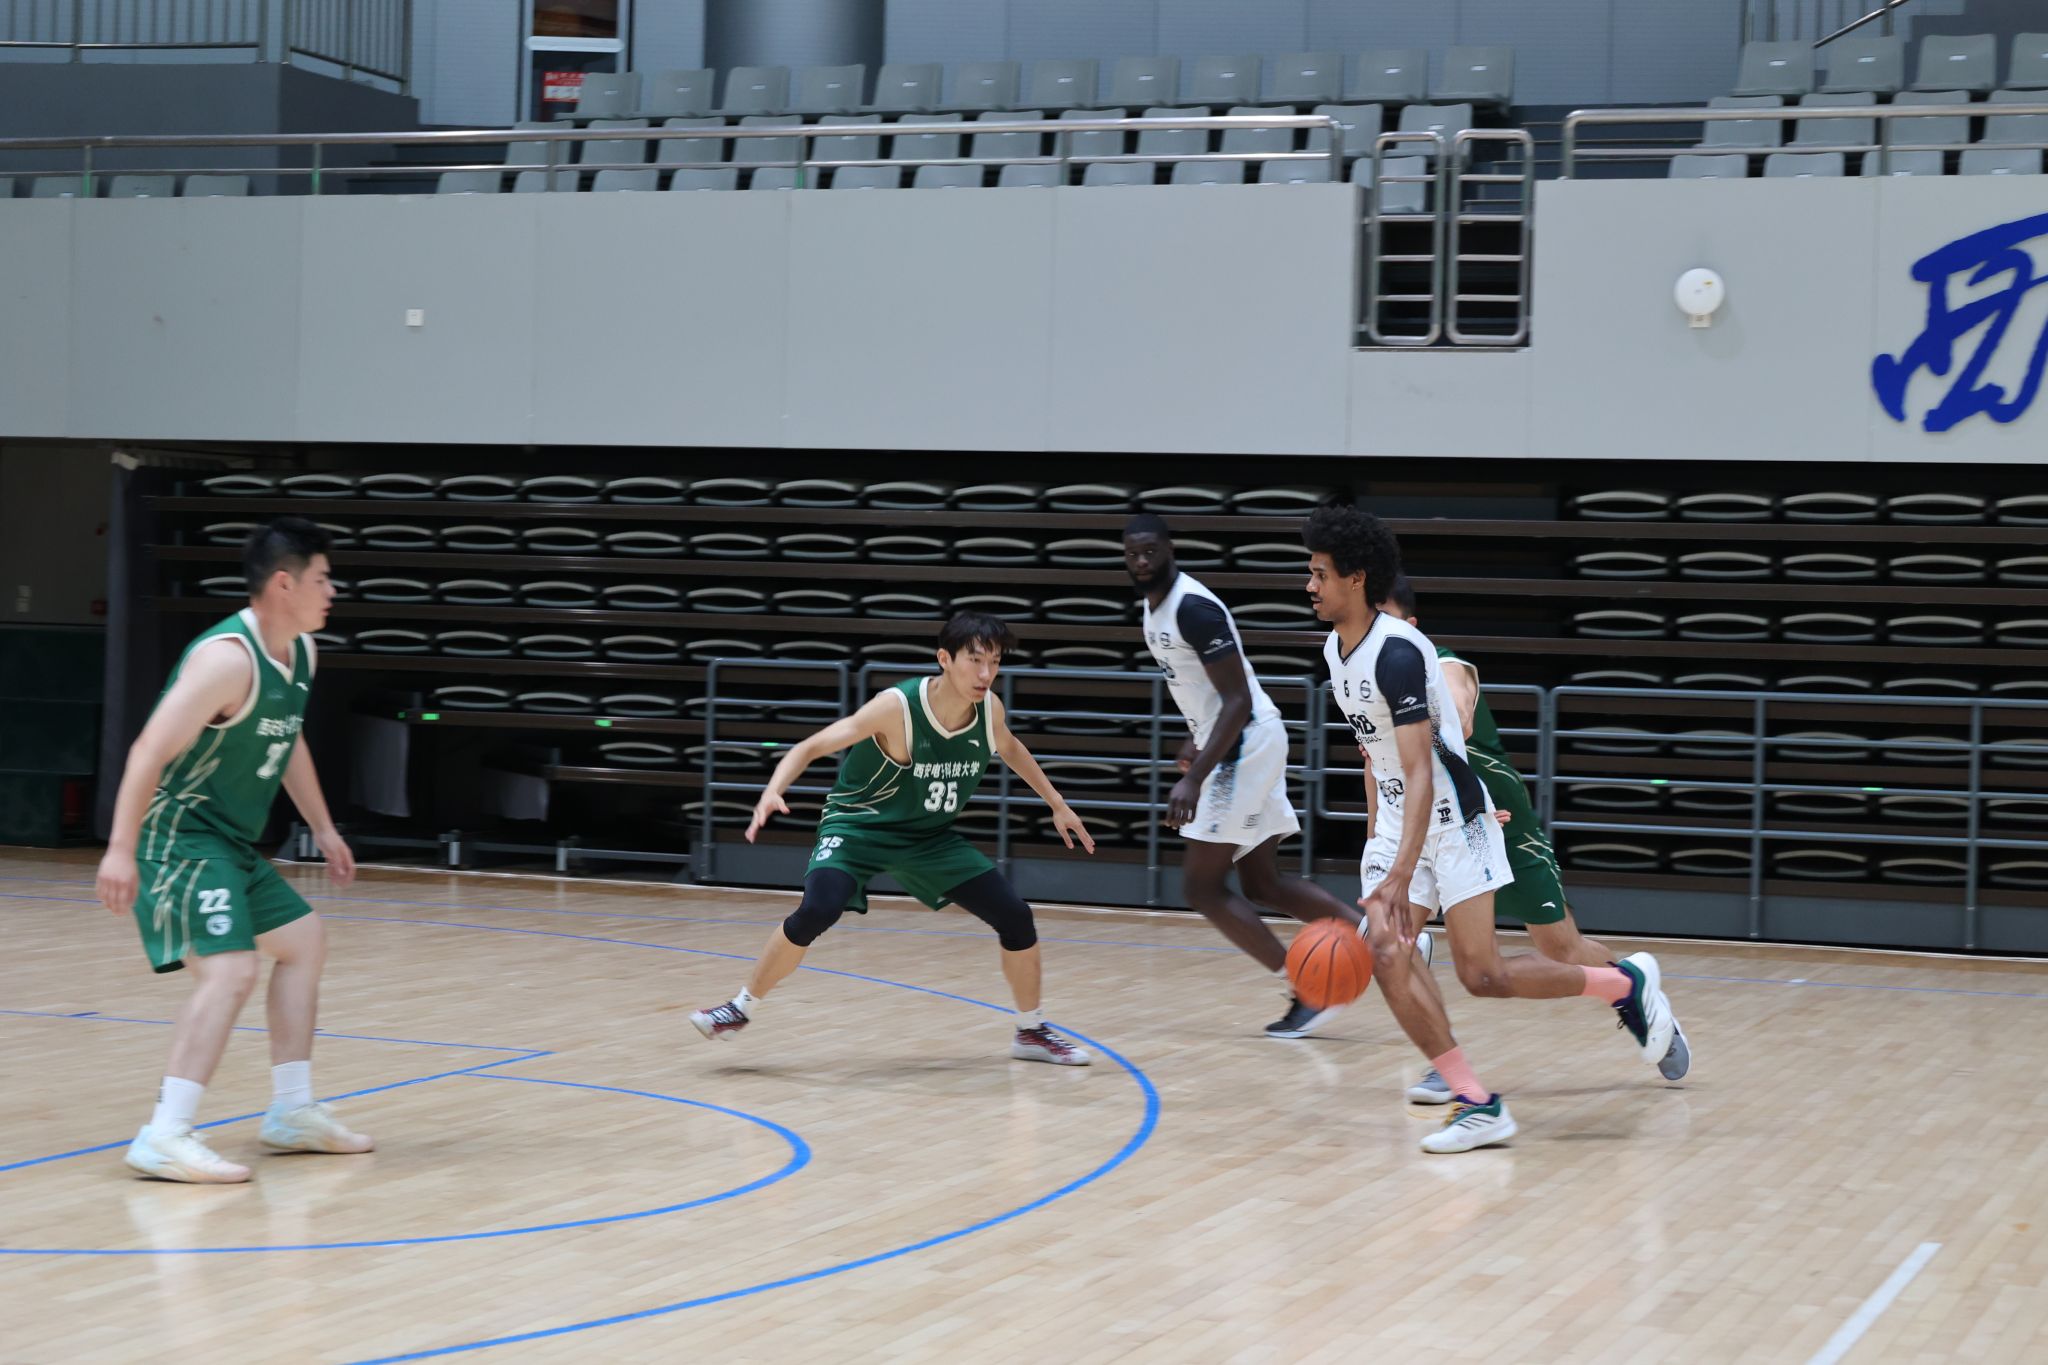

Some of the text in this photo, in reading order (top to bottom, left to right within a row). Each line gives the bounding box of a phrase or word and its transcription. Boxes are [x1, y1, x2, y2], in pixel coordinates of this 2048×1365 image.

[1343, 679, 1350, 698] 6
[924, 780, 958, 813] 35
[197, 887, 232, 914] 22
